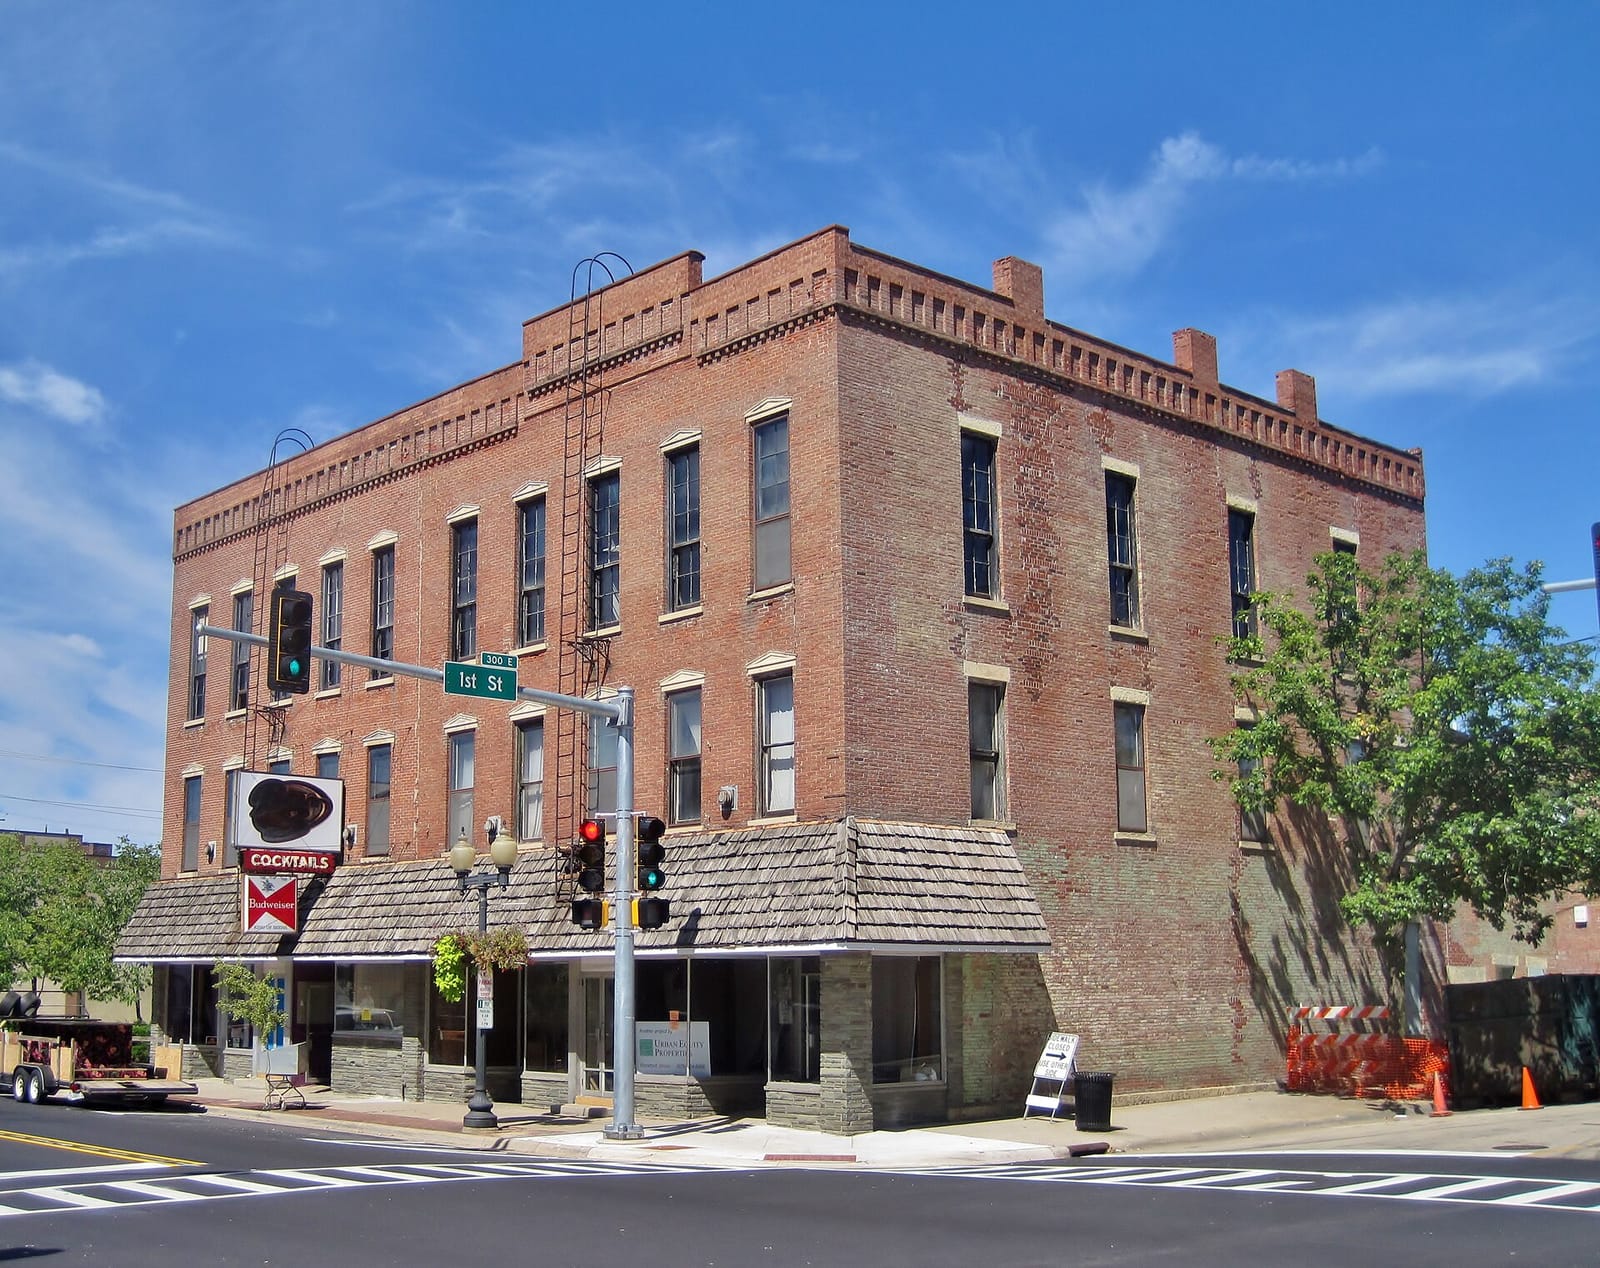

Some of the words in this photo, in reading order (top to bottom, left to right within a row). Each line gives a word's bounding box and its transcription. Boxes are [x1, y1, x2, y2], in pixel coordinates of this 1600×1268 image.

[486, 655, 503, 665] 300
[507, 657, 513, 667] E
[459, 671, 477, 689] 1st
[487, 675, 503, 692] St
[250, 853, 329, 869] COCKTAILS
[249, 898, 295, 909] Budweiser
[654, 1039, 678, 1048] URBAN
[679, 1039, 705, 1048] EQITY
[1048, 1042, 1071, 1051] CLOSED
[654, 1048, 693, 1057] PROPERTIS
[1039, 1060, 1050, 1068] USE
[1050, 1061, 1068, 1070] OTHER
